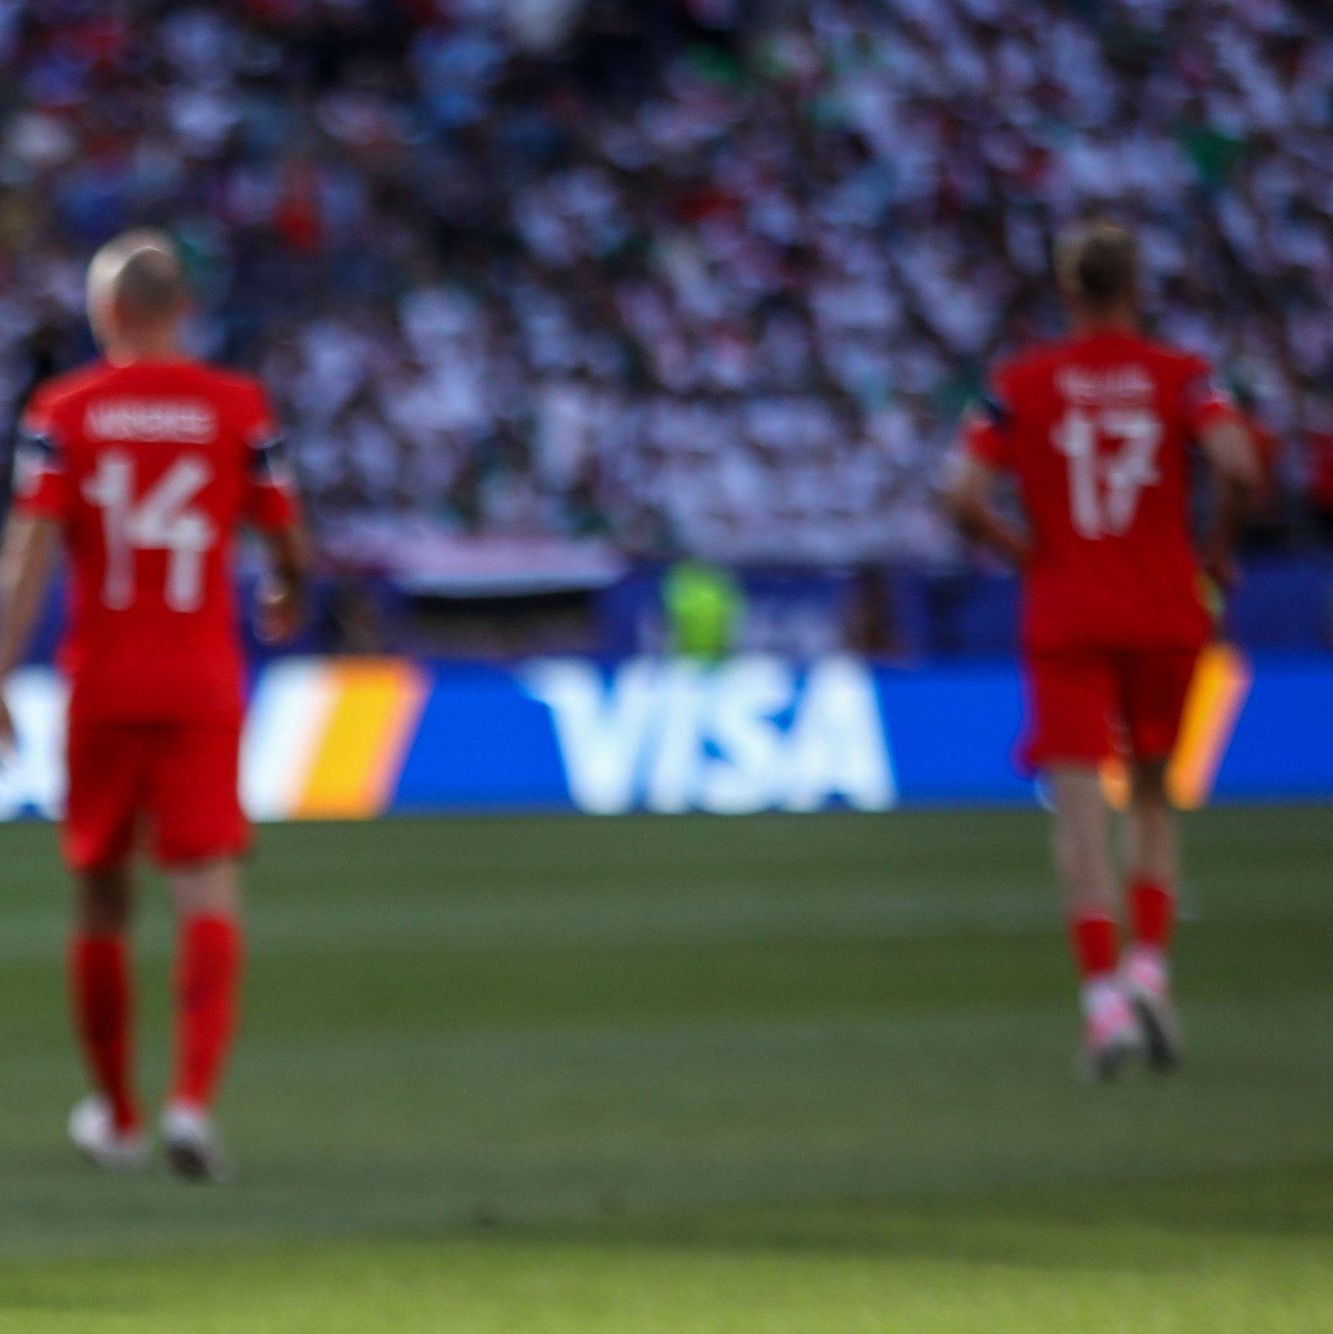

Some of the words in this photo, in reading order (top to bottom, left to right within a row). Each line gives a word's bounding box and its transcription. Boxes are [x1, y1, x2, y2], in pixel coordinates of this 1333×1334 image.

[80, 449, 217, 613] 14
[1049, 408, 1165, 540] 17
[521, 656, 898, 814] VISA
